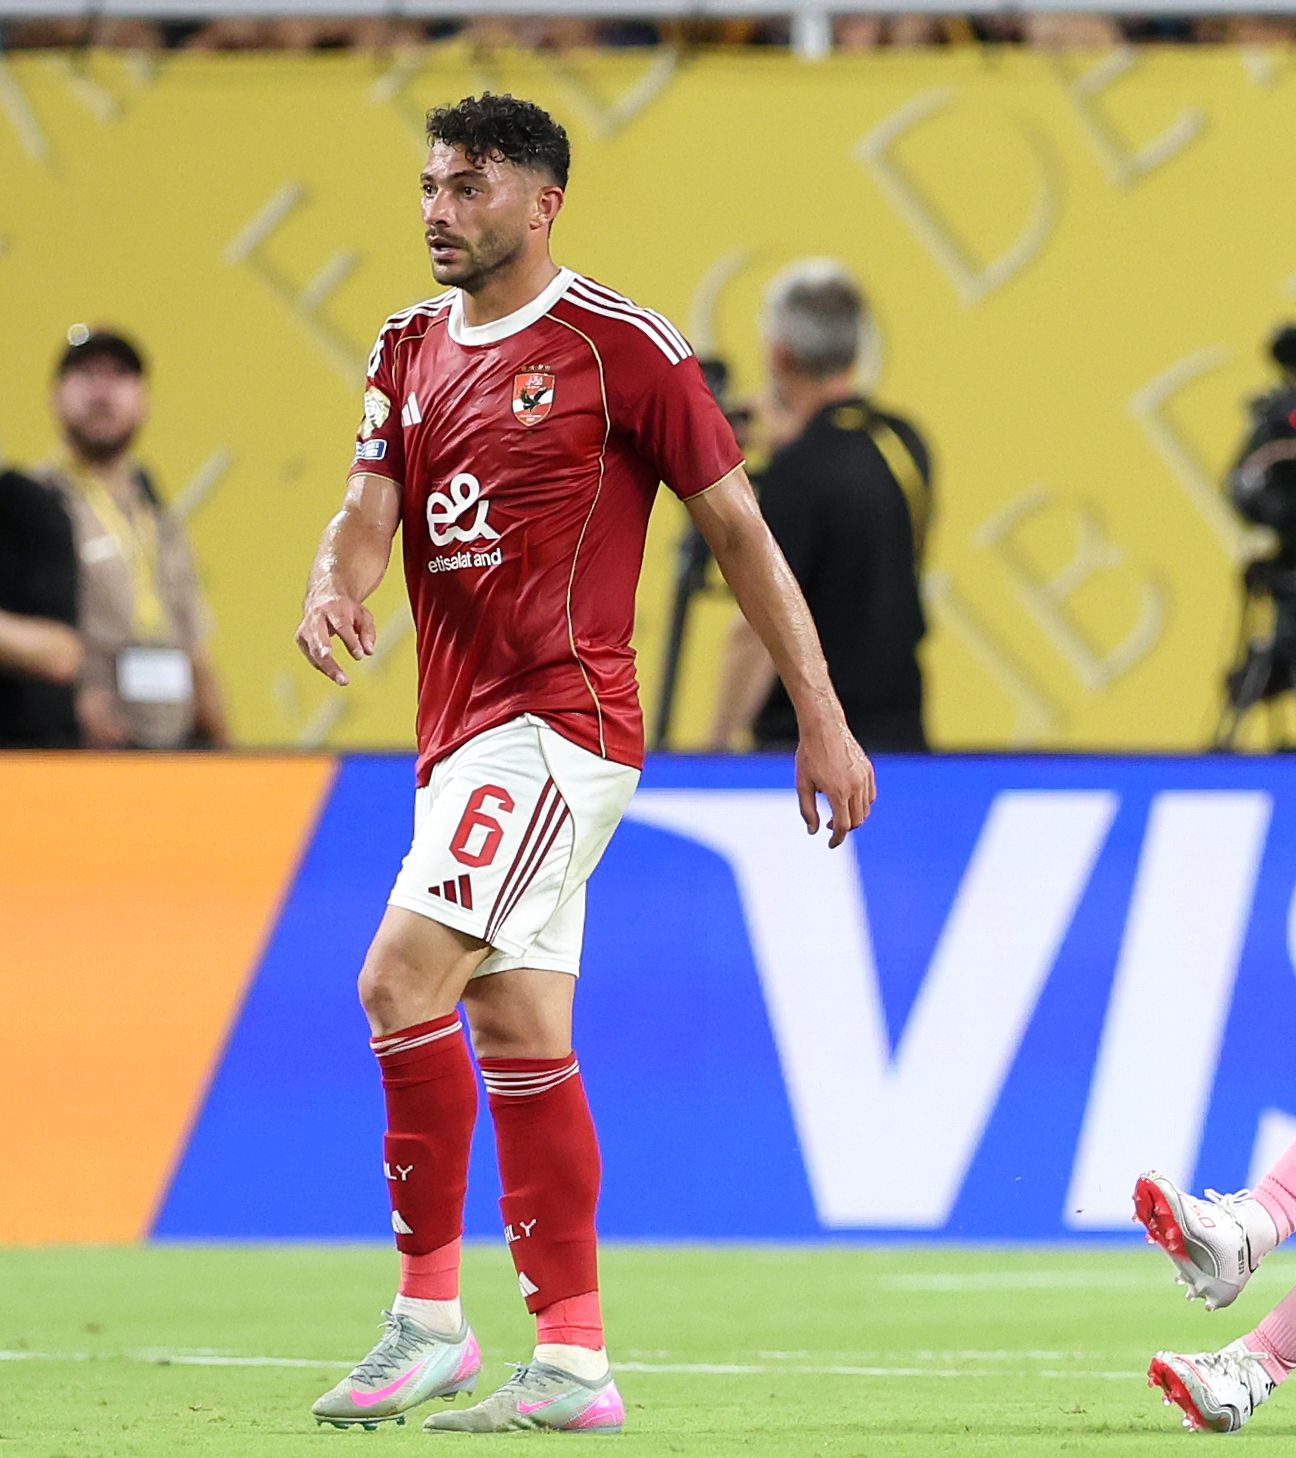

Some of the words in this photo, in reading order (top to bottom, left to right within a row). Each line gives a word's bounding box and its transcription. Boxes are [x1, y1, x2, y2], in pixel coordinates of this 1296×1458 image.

[428, 552, 473, 573] etisalat
[473, 548, 502, 567] and
[449, 784, 515, 868] 6
